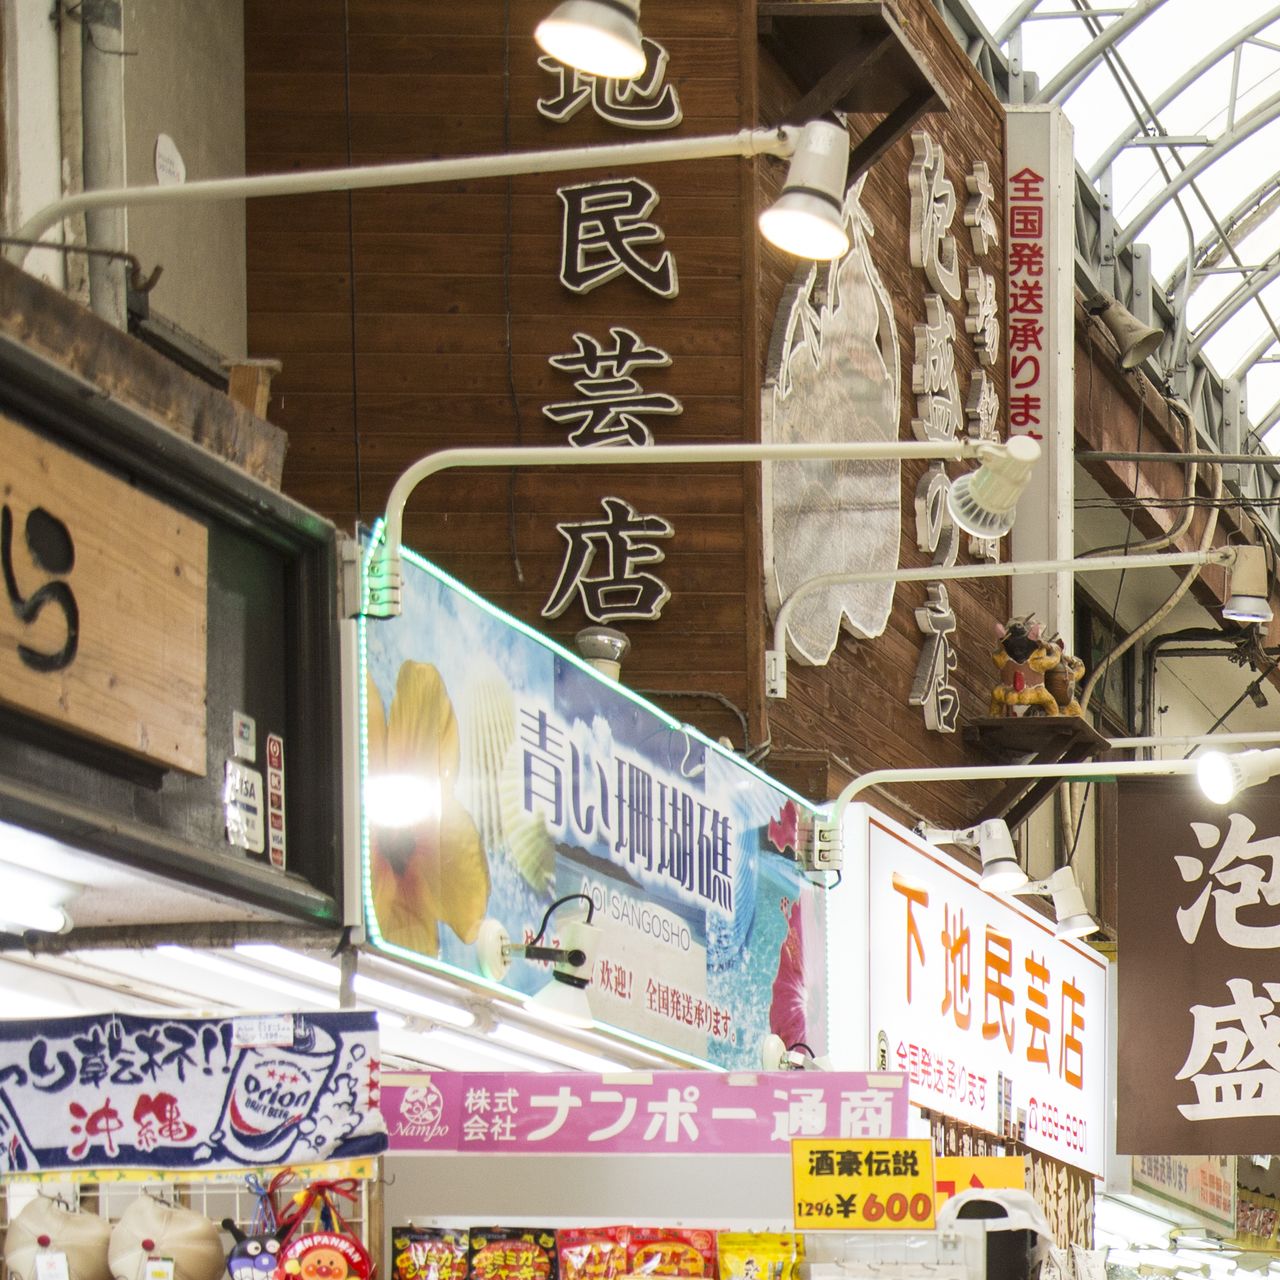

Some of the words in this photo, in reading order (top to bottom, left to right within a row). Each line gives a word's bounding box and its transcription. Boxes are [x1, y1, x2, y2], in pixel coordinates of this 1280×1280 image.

[1008, 167, 1045, 440] 全国発送承りま
[519, 706, 734, 913] 青い珊瑚礁
[611, 894, 692, 951] SANGOSHO
[892, 871, 1086, 1091] 下地民芸店
[244, 1074, 313, 1110] Orion
[464, 1087, 518, 1115] 株式
[526, 1086, 893, 1143] ナンポー通商
[69, 1094, 198, 1158] 沖縄
[463, 1114, 518, 1142] 会社
[808, 1150, 920, 1177] 酒豪伝説
